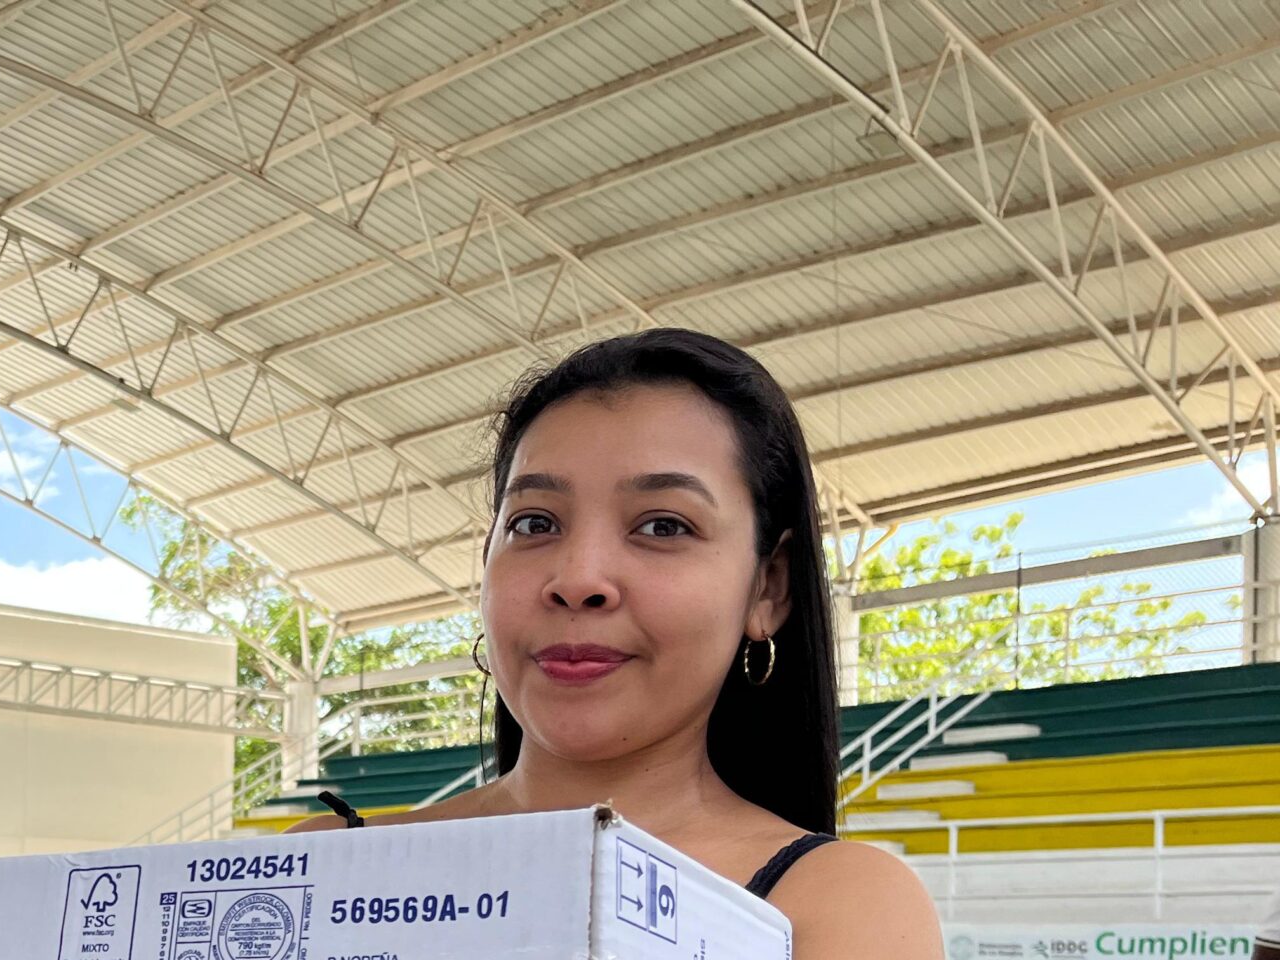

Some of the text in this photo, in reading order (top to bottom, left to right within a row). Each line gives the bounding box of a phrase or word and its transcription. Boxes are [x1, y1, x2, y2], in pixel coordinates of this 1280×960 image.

[187, 853, 309, 882] 13024541
[162, 895, 175, 904] 25
[658, 884, 674, 918] 6
[82, 914, 116, 928] FSC
[238, 941, 253, 950] 790
